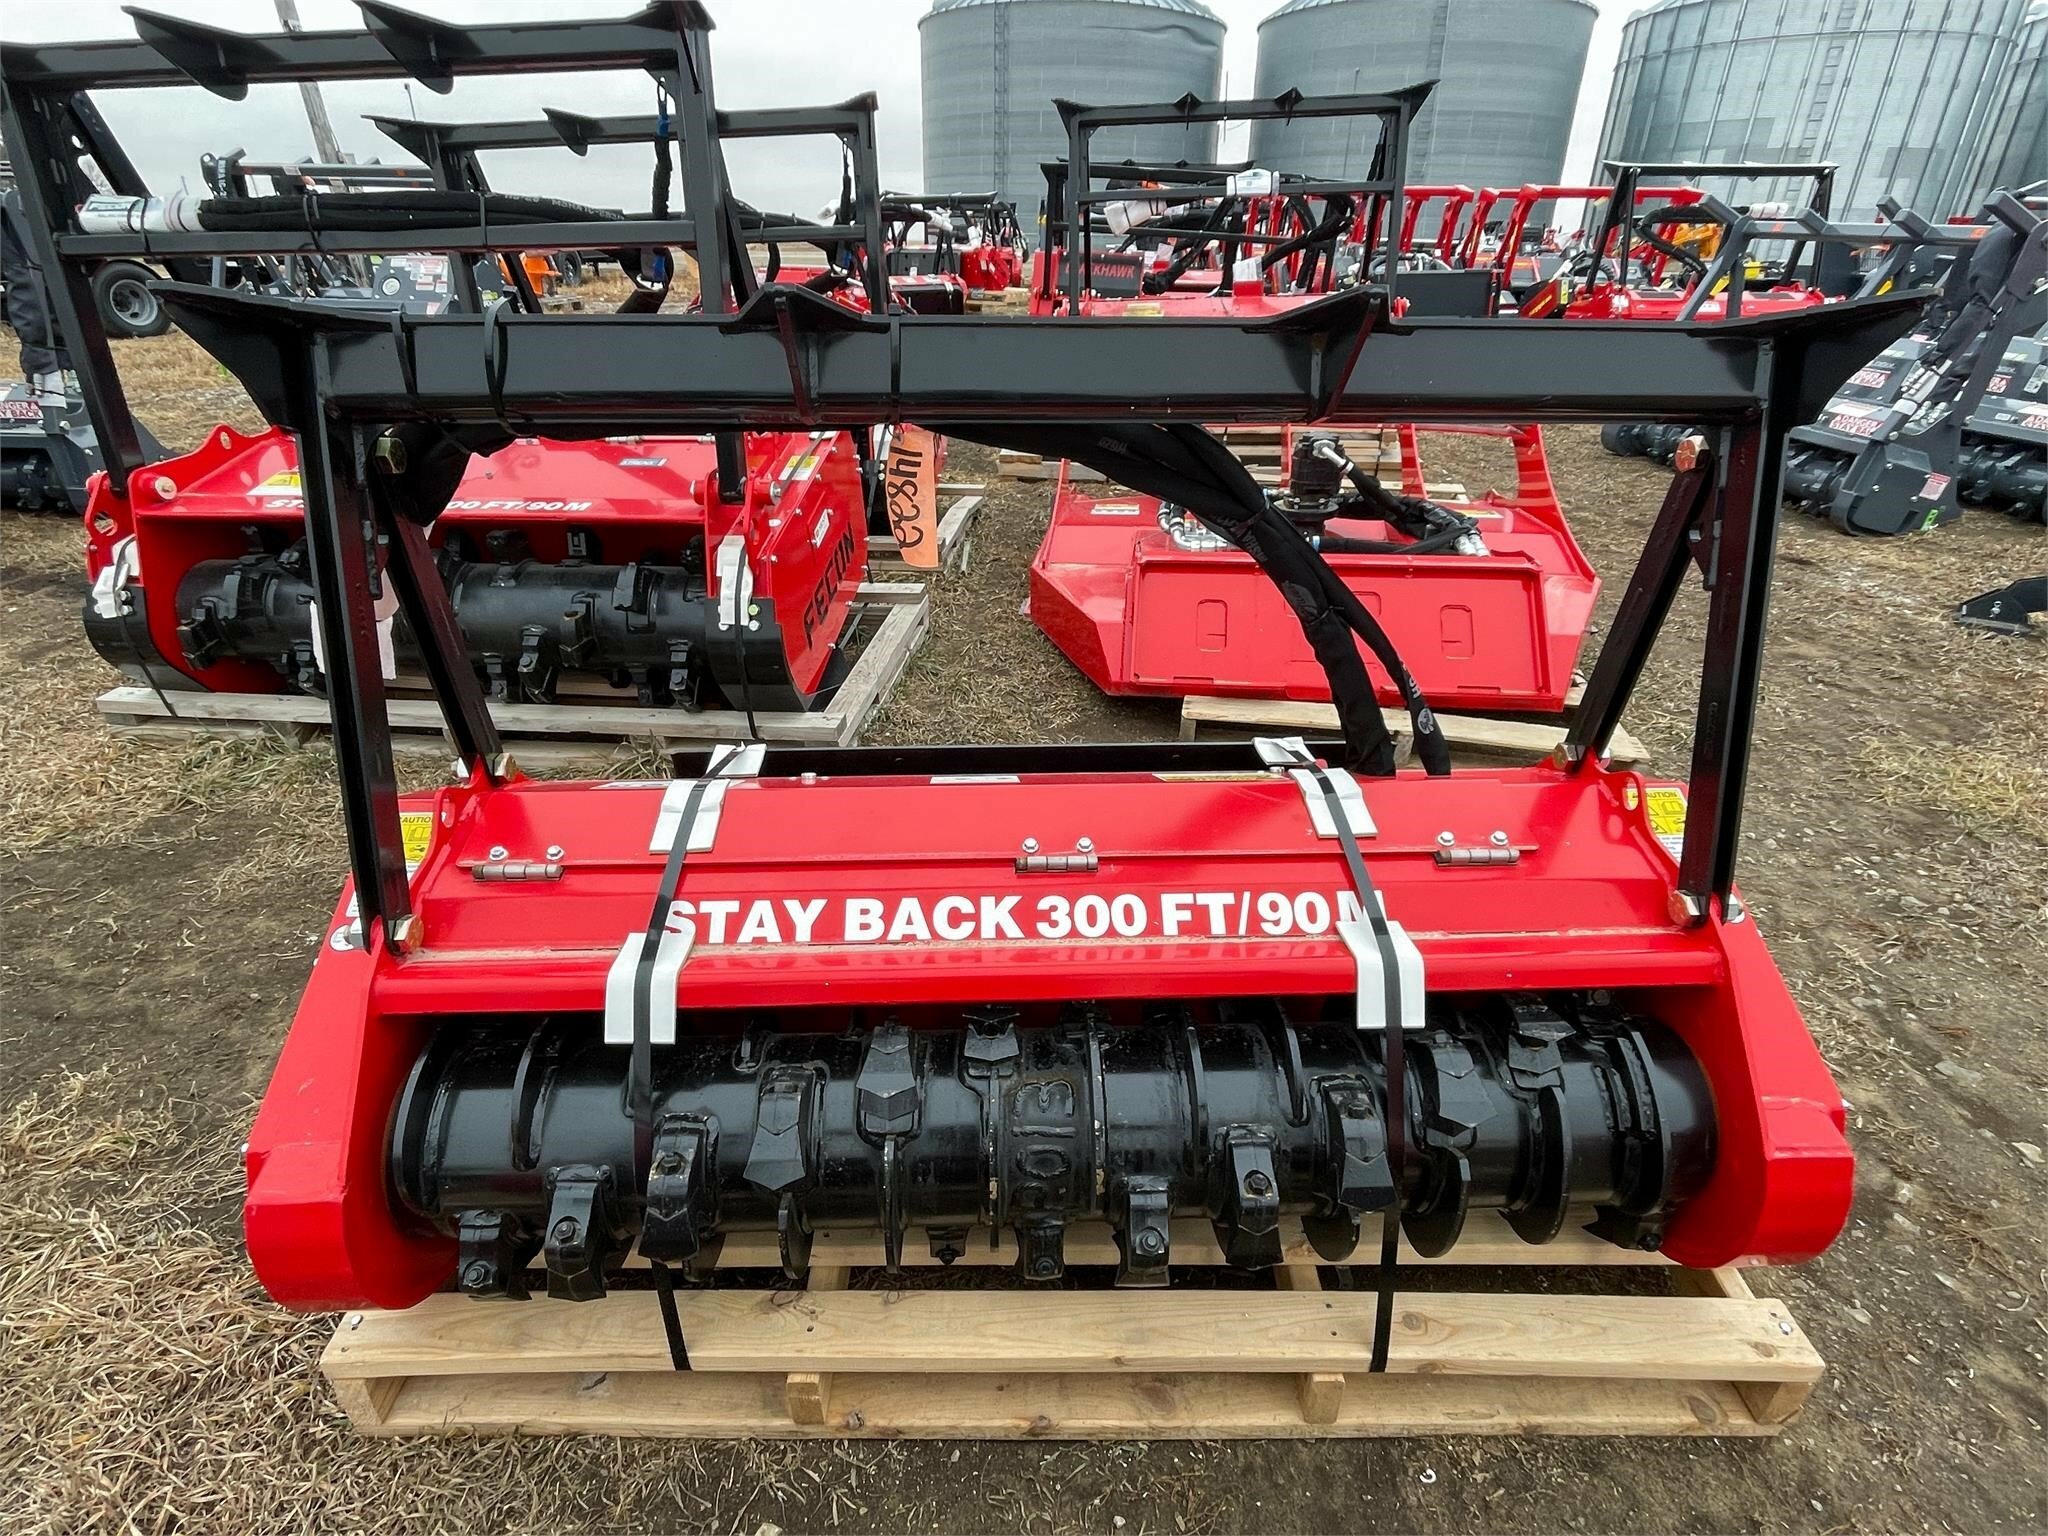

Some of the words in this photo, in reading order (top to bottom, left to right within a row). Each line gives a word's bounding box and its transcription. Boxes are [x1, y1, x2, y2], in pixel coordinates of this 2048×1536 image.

[1064, 262, 1135, 279] AKHAWK
[0, 401, 31, 410] NGER
[887, 446, 924, 550] 14822
[446, 500, 477, 511] 00
[803, 521, 856, 650] FECON
[1644, 790, 1679, 799] AUTION
[400, 816, 433, 824] AUTIO
[662, 898, 828, 945] STAY
[843, 894, 1026, 942] BACK
[1035, 893, 1148, 938] 300
